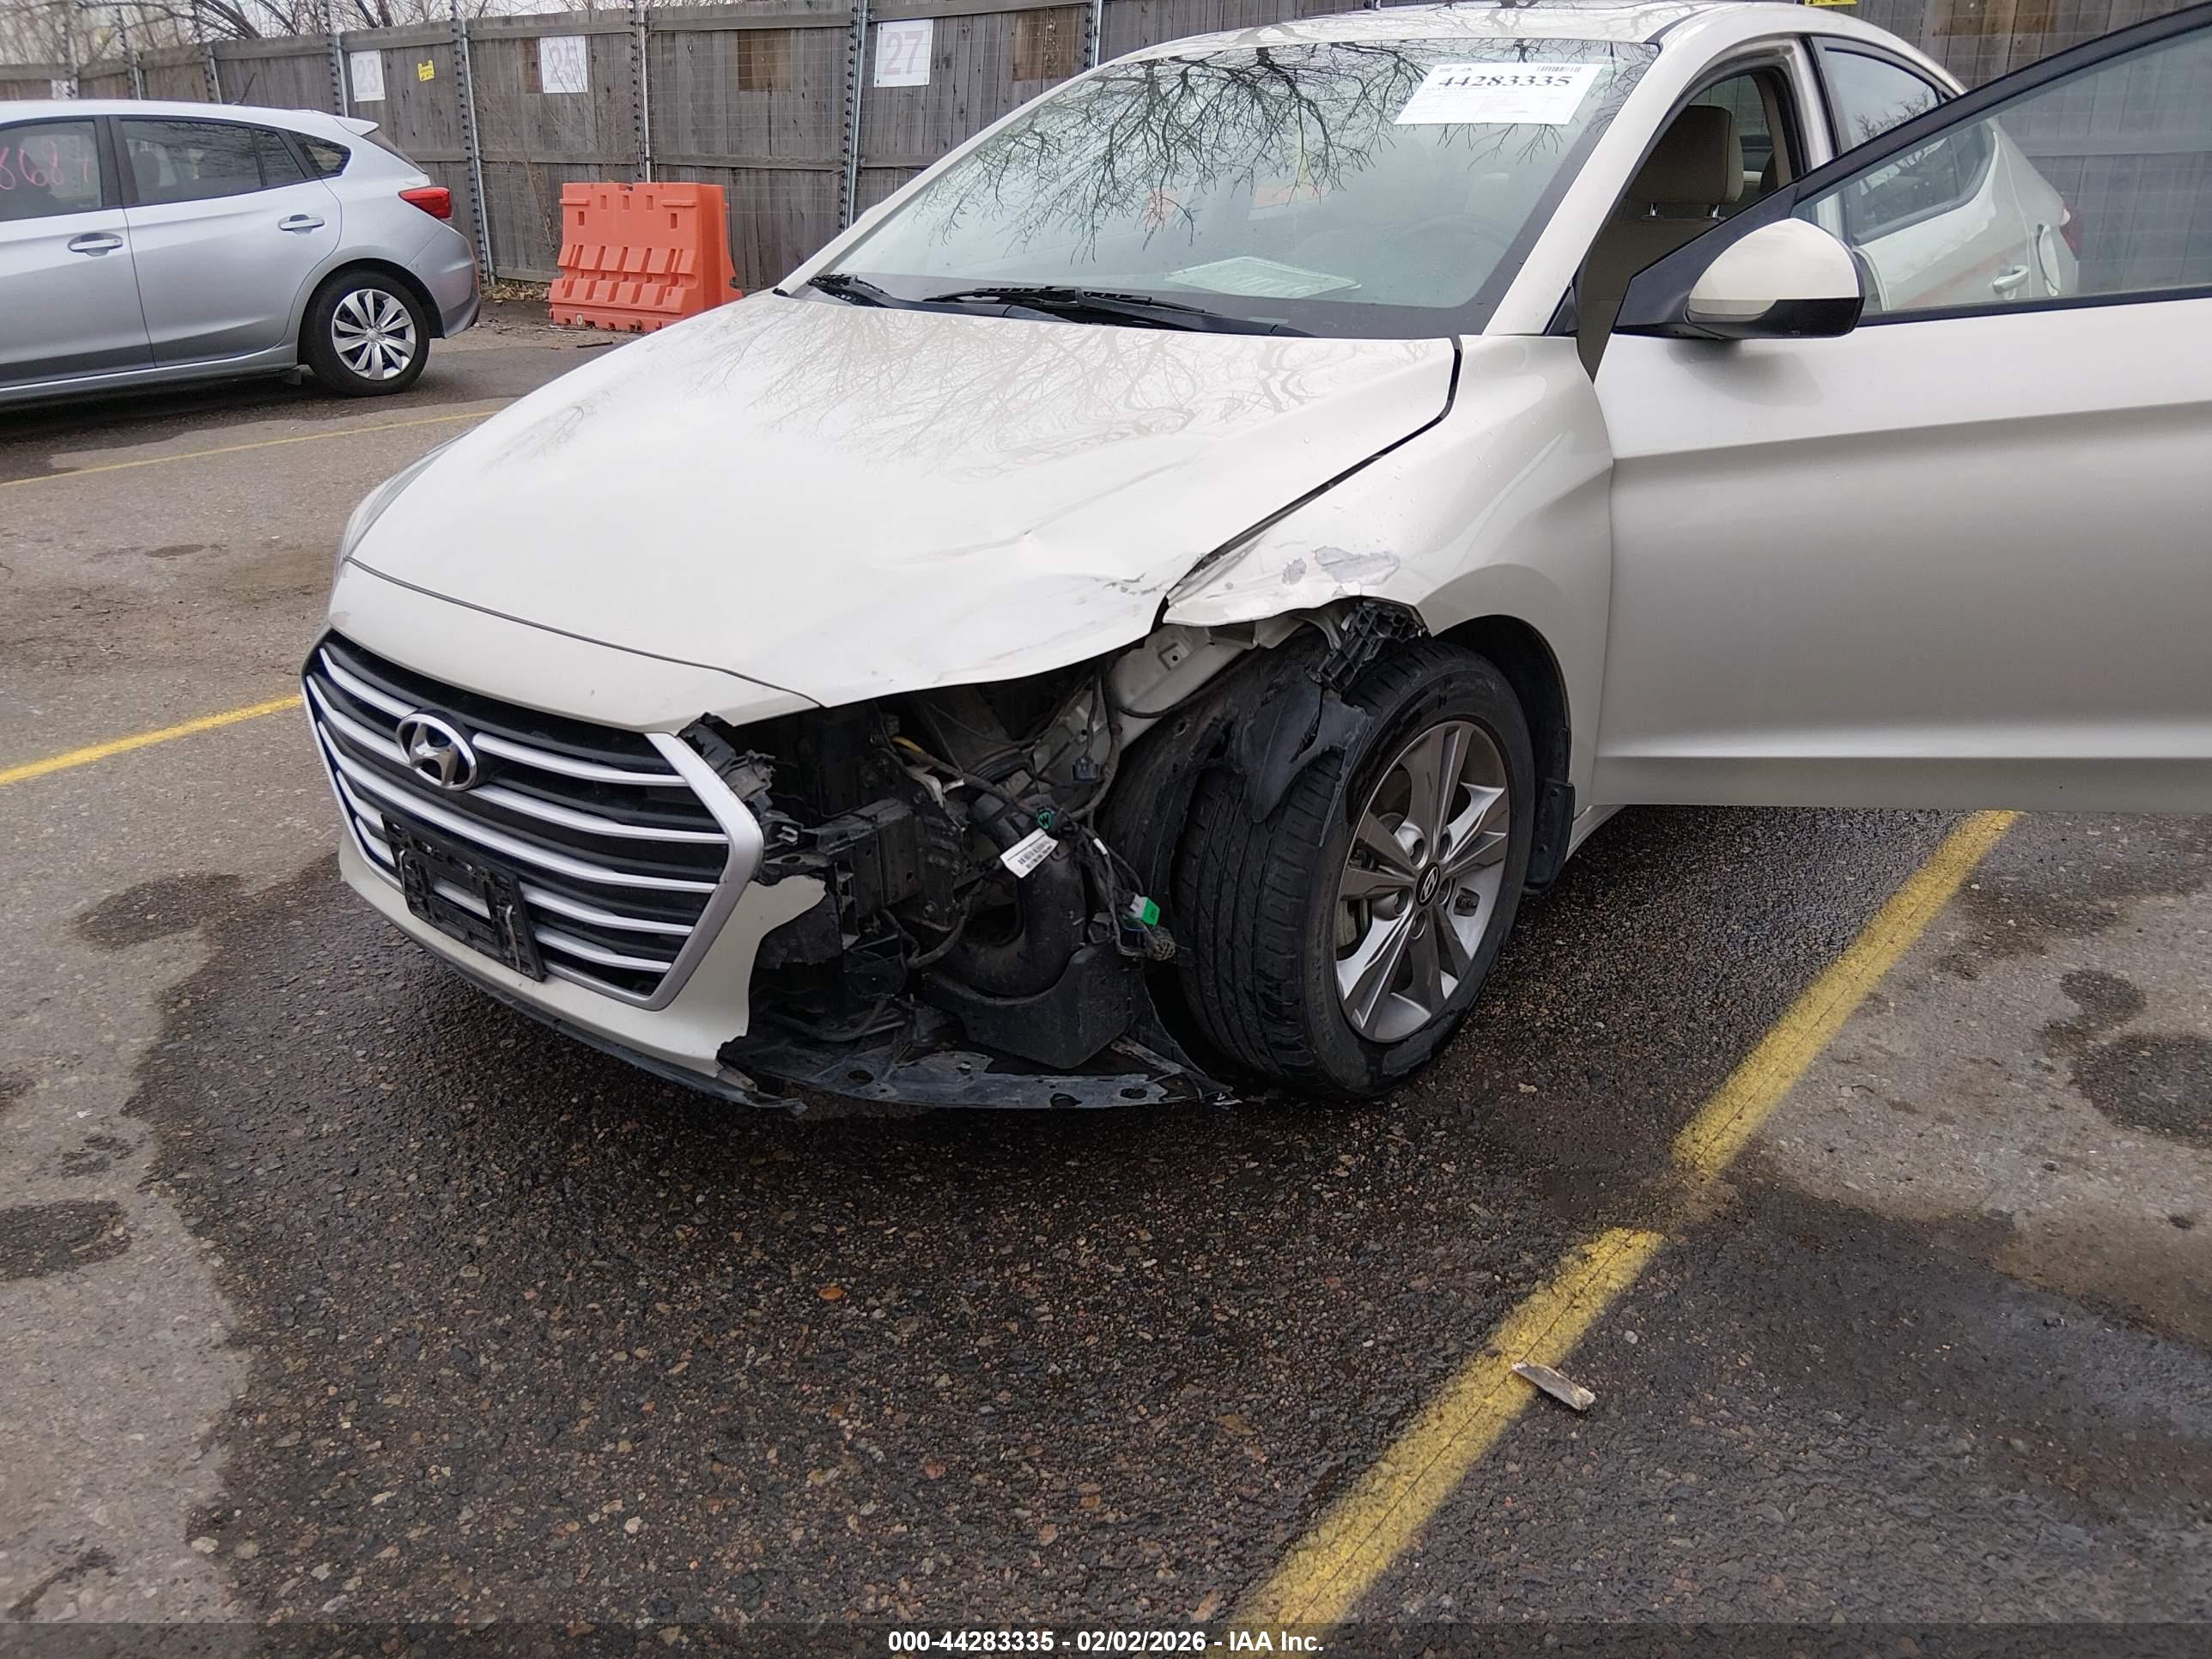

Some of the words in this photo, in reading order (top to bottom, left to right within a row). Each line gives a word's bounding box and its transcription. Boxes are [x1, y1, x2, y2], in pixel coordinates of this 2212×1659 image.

[884, 31, 924, 76] 27
[356, 58, 379, 93] 23
[1438, 76, 1572, 87] 44283335
